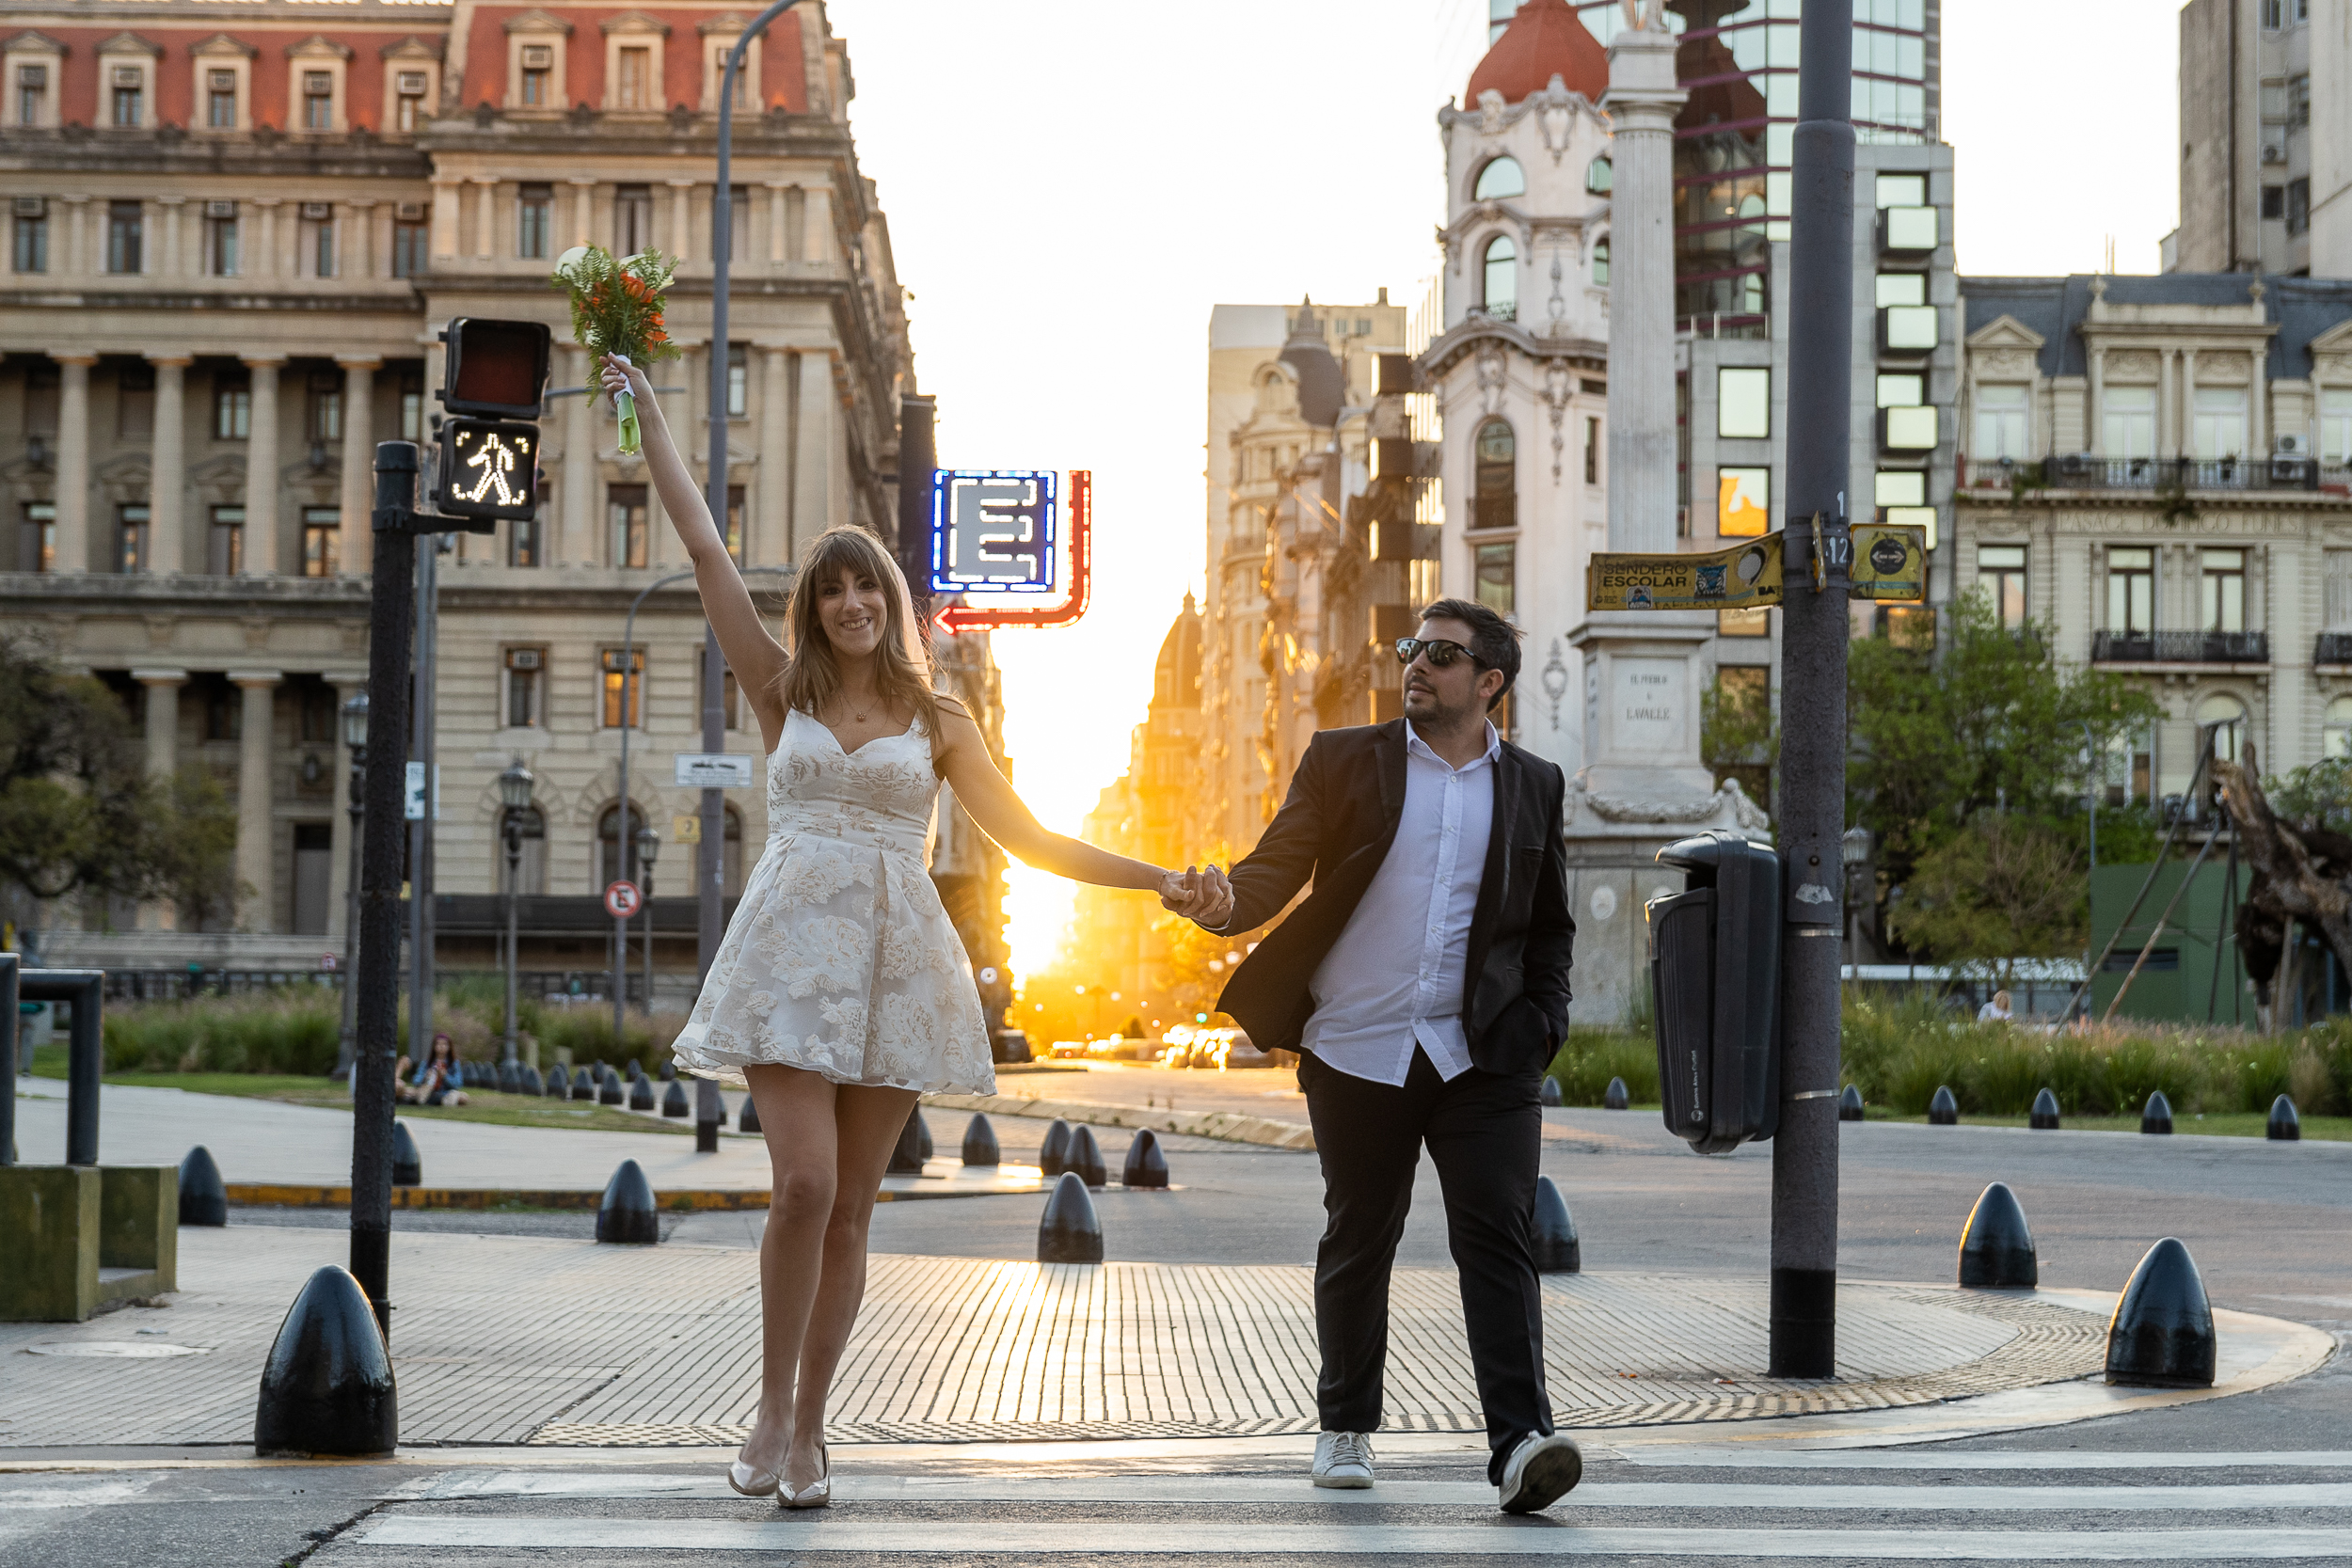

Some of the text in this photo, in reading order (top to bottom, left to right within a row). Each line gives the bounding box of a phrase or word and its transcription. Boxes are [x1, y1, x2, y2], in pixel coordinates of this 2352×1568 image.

[948, 478, 1038, 583] E
[1603, 564, 1689, 576] SENDERO
[1603, 576, 1688, 588] ESCOLAR
